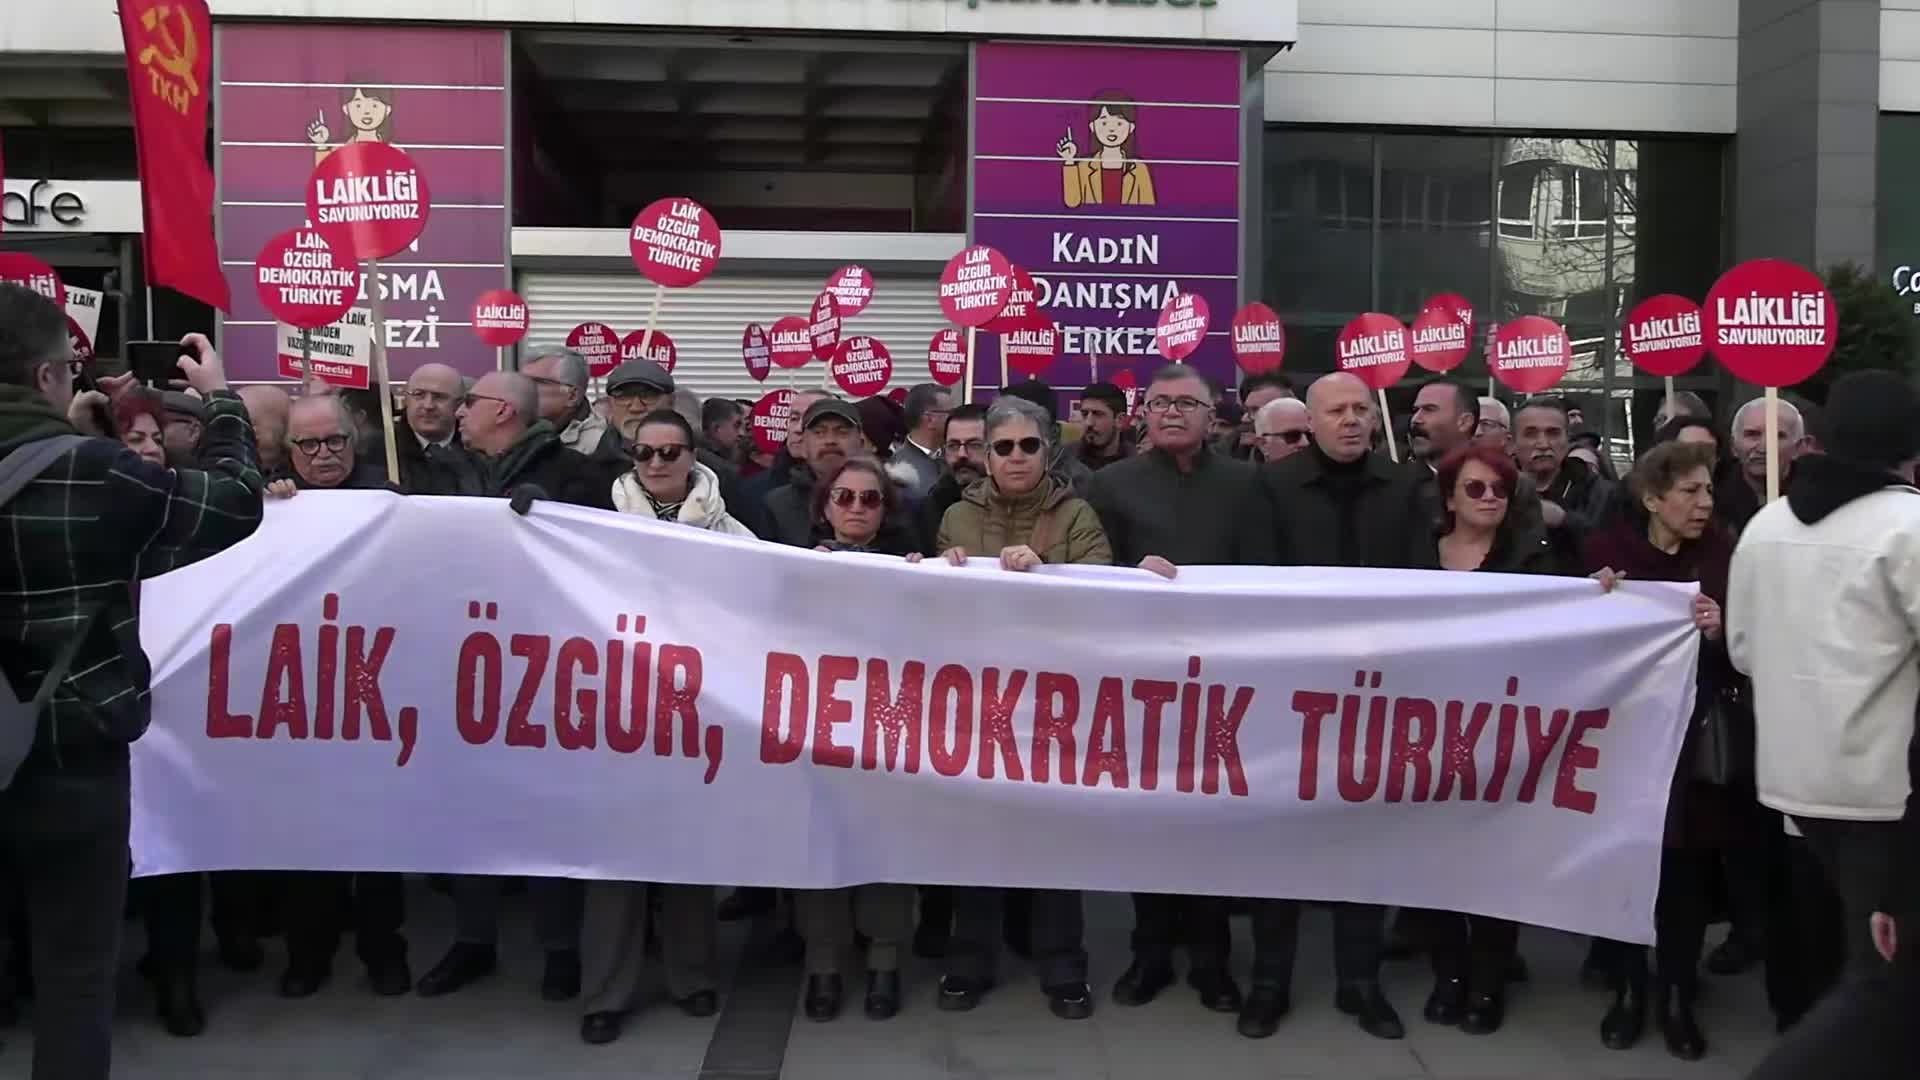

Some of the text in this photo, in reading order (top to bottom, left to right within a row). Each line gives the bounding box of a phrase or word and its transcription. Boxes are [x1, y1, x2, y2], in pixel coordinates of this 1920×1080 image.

[148, 66, 189, 115] TKH
[316, 169, 418, 205] LAİKLİĞİ
[318, 204, 420, 223] SAVUNUYORUZ
[671, 201, 701, 222] LAİK
[657, 213, 700, 239] ÖZGÜR
[633, 225, 716, 258] DEMOKRATİK
[1052, 232, 1159, 265] KADIN
[283, 248, 332, 269] ÖZGÜR
[648, 246, 702, 272] TÜRKİYE
[966, 247, 990, 264] LAİK
[259, 267, 355, 287] DEMOKRATİK
[958, 264, 991, 280] ÖZGÜR
[280, 285, 342, 305] TÜRKİYE
[941, 274, 1008, 297] DEMOKRATİK
[73, 292, 97, 308] LAİK
[954, 291, 998, 311] TÜRKİYE
[1032, 278, 1179, 319] DANIŞMA
[1717, 291, 1825, 326] LAİKLİĞİ
[1234, 321, 1280, 342] LAİKLİĞİ
[1412, 322, 1465, 344] LAİKLİĞİ
[1629, 310, 1701, 342] LAİKLİĞİ
[1718, 328, 1825, 345] SAVUNUYORUZ
[1340, 328, 1404, 358] LAİKLİĞİ
[1497, 333, 1563, 358] LAİKLİĞİ
[1632, 334, 1702, 354] SAVUNUYORUZ
[834, 355, 889, 375] DEMOKRATİK
[1342, 351, 1406, 369] SAVUNUYORUZ
[847, 370, 883, 385] TÜRKİYE
[206, 593, 1611, 815] LAİK, ÖZGÜR, DEMOKRATİK TÜRKİYE
